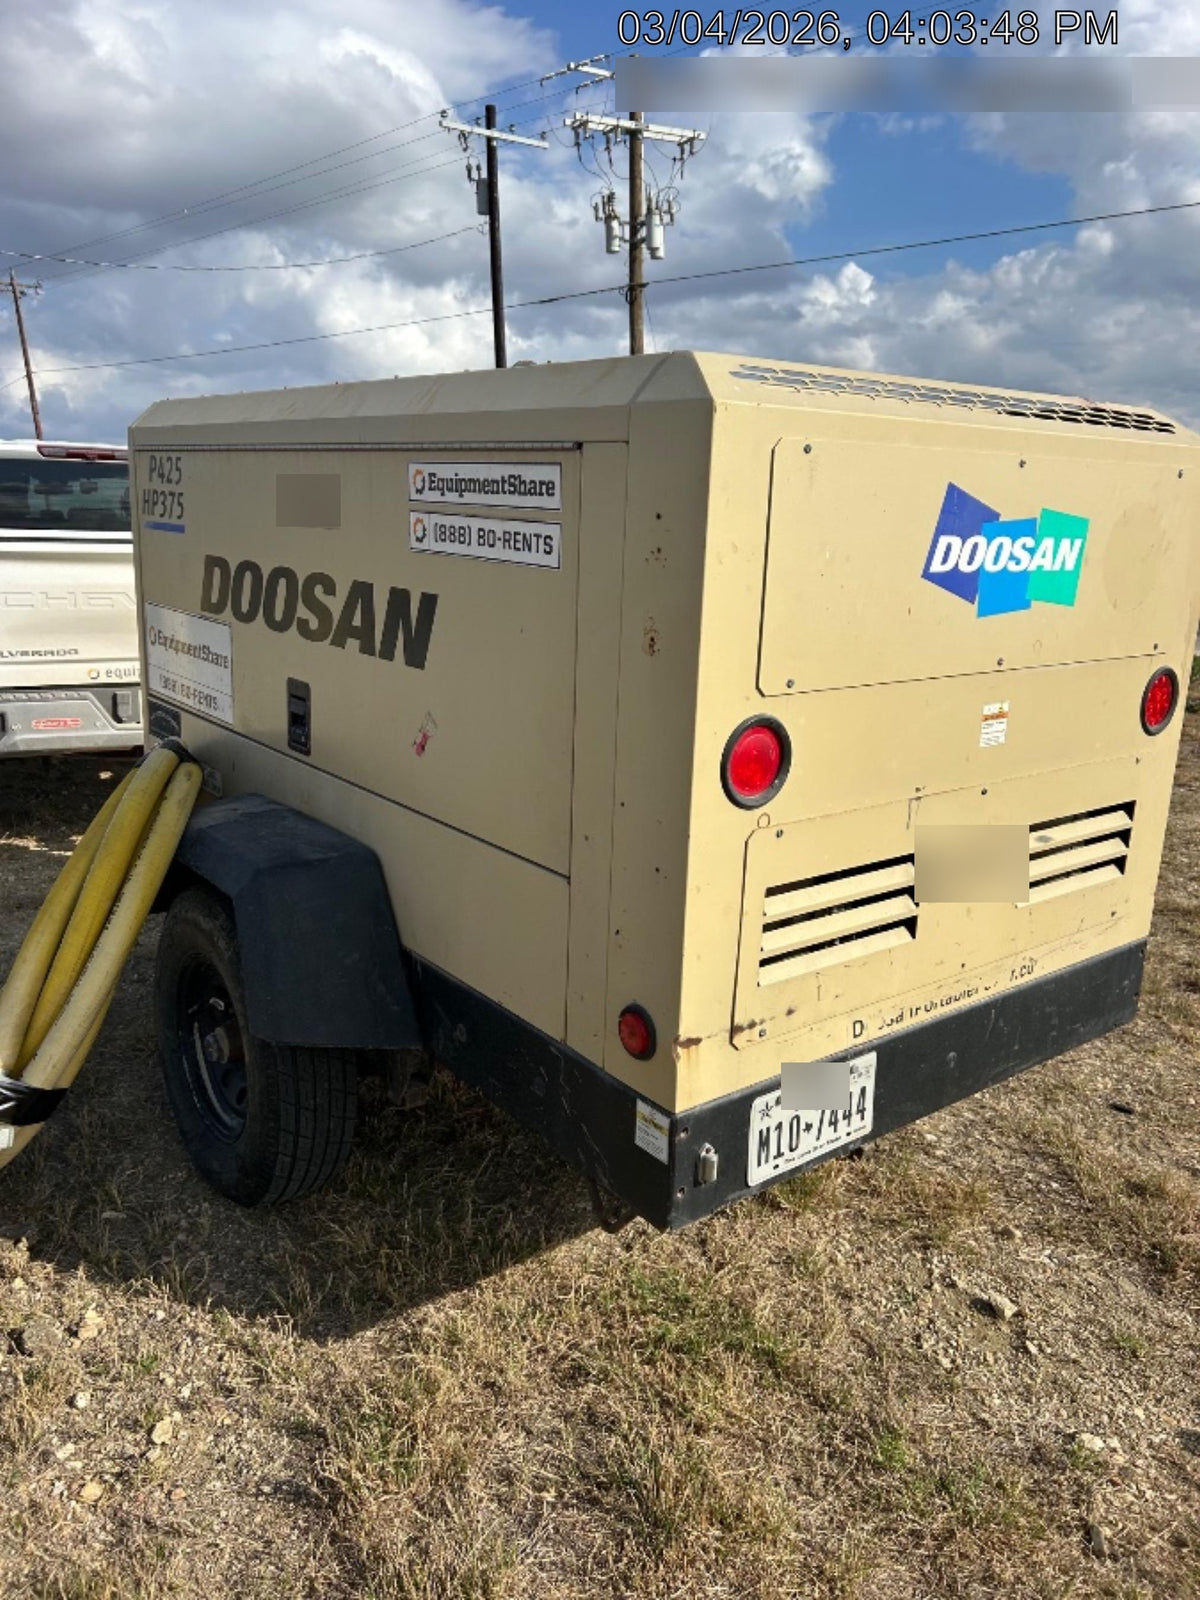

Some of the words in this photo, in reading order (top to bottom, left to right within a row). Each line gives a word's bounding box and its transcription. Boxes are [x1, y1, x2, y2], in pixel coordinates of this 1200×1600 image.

[149, 455, 183, 486] P425
[427, 472, 556, 498] EquipmentShare
[142, 488, 185, 520] HP375
[434, 521, 472, 547] (888)
[477, 527, 554, 556] BO-RENTS
[929, 534, 1083, 574] DOOSAN
[200, 554, 439, 670] DOOSAN
